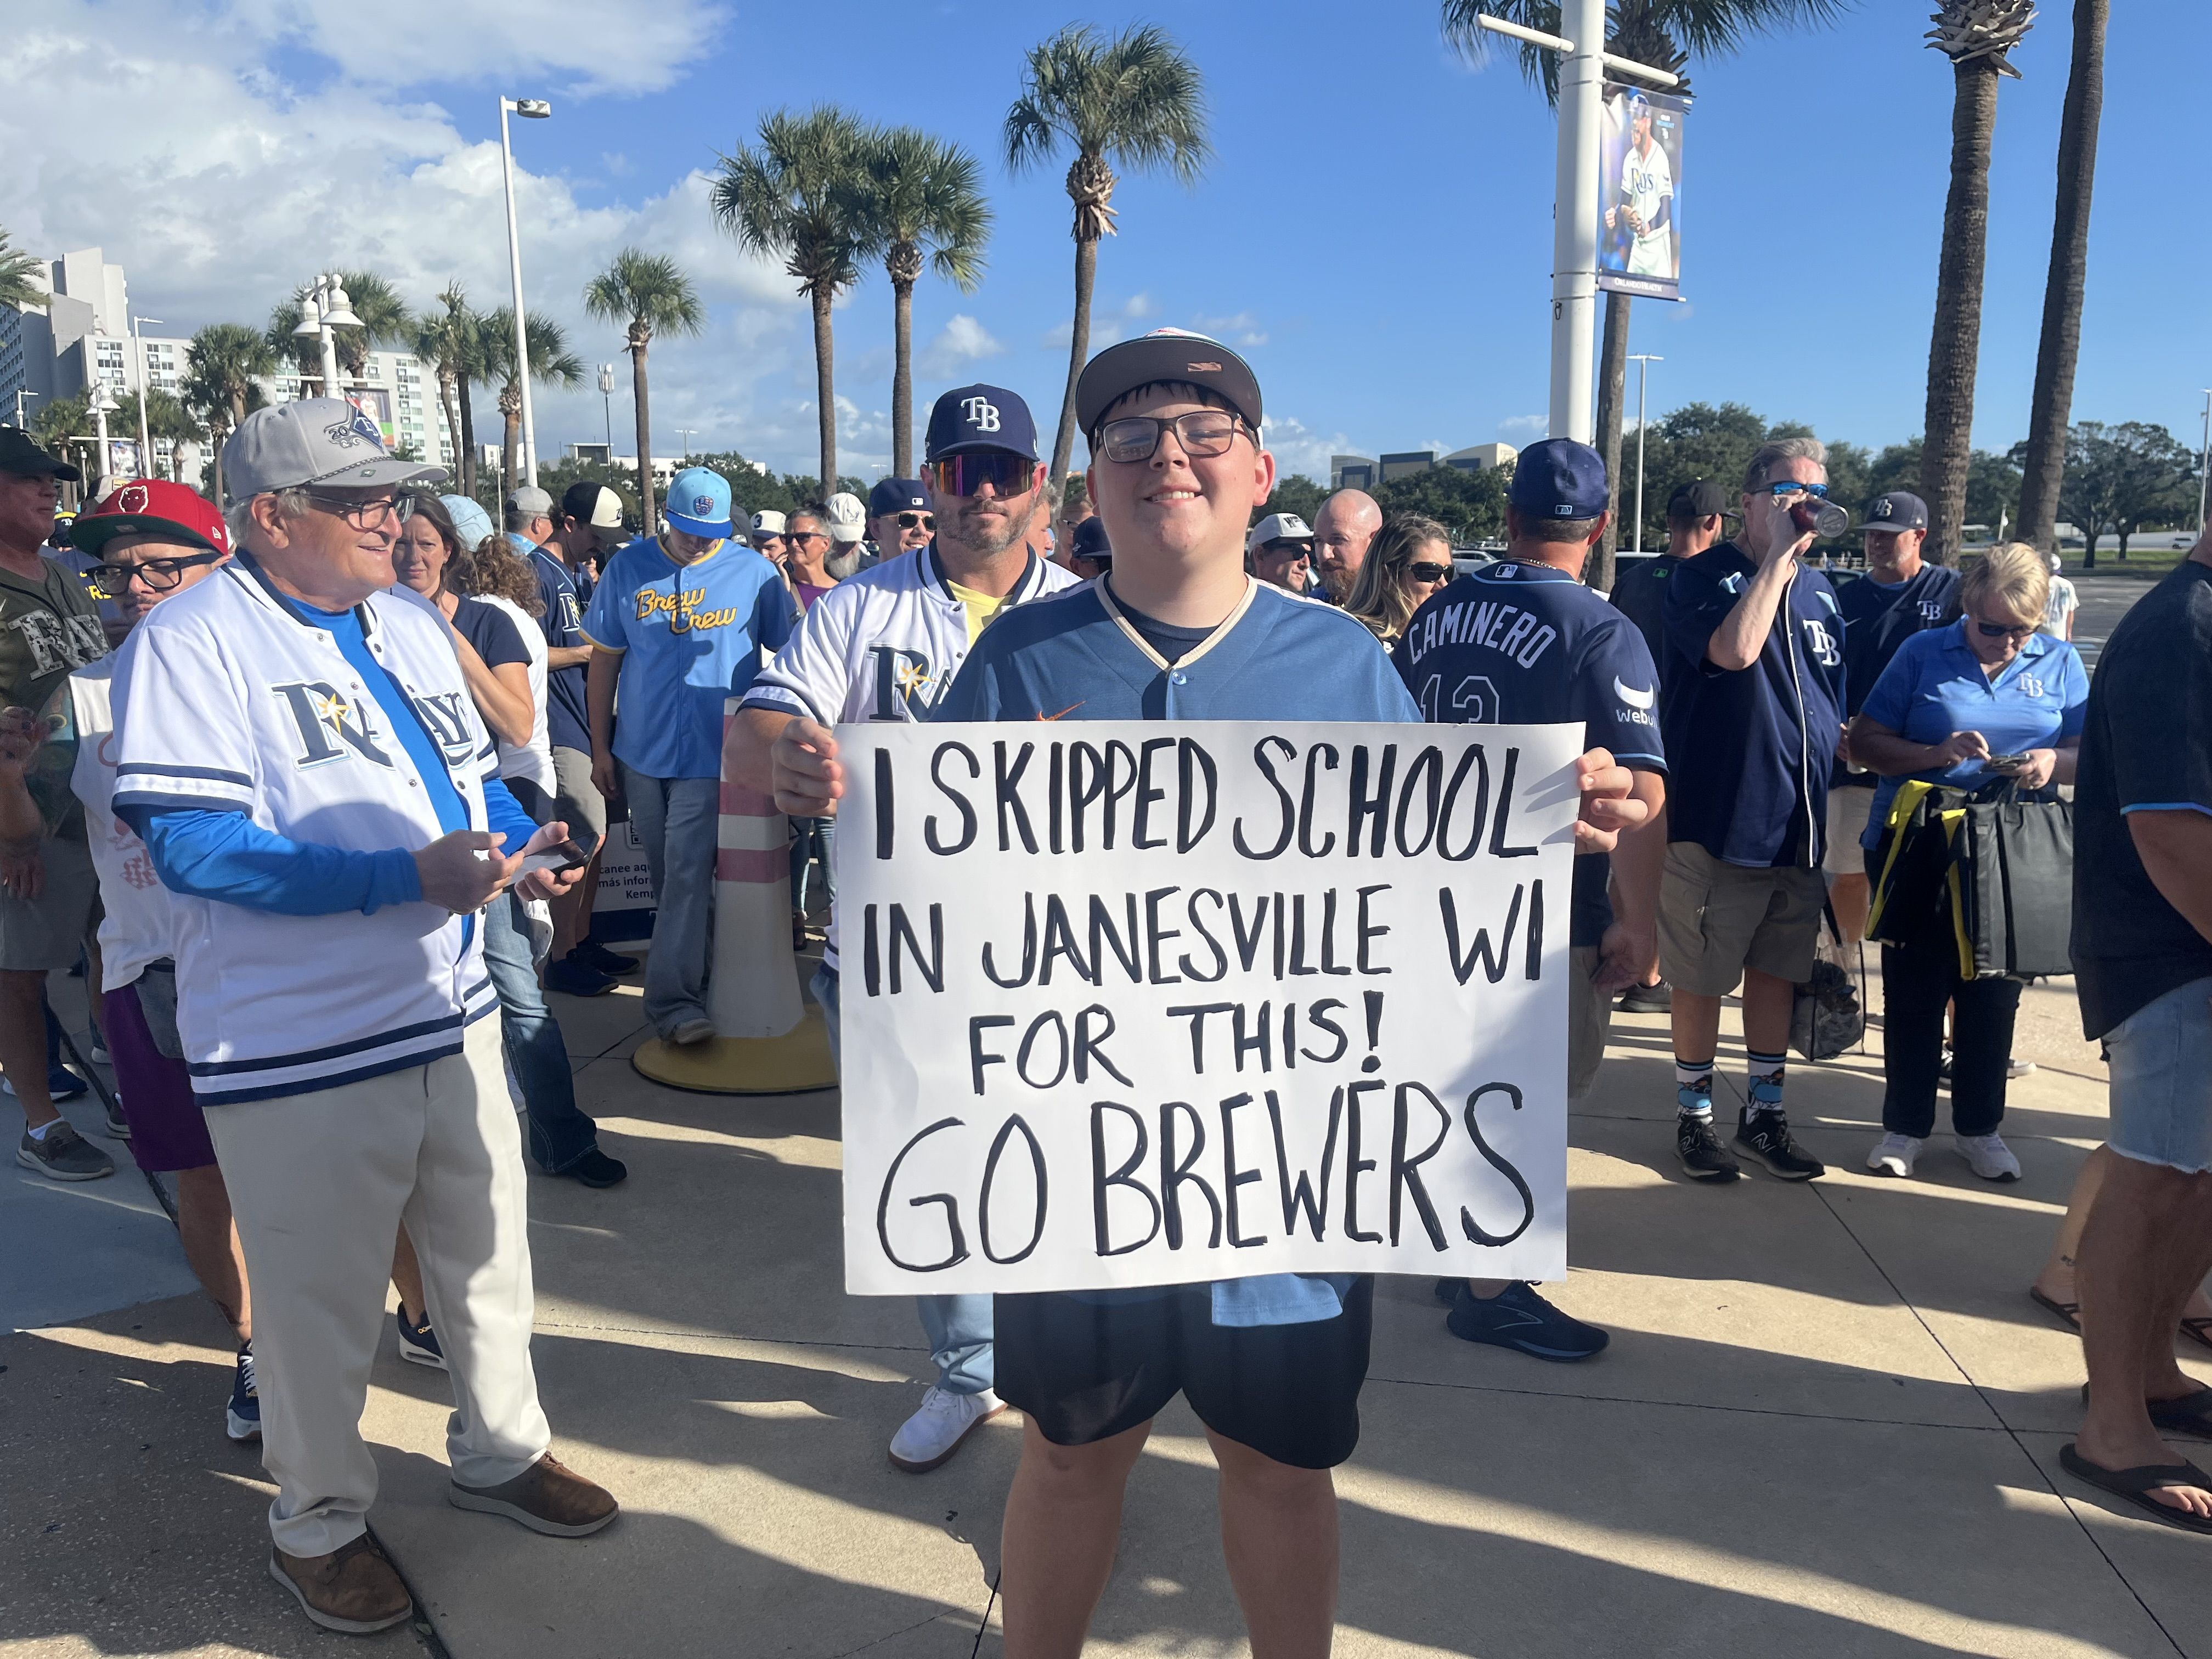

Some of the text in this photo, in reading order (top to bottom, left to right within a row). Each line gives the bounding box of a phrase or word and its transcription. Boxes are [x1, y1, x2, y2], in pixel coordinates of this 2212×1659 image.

[961, 397, 1001, 432] TB
[754, 513, 763, 529] 3
[635, 588, 707, 621] Brew
[670, 607, 737, 635] Crew
[1917, 601, 1941, 620] TB
[1409, 601, 1556, 668] CAMINERO
[1802, 619, 1841, 666] TB
[2017, 672, 2044, 697] TB
[876, 736, 1539, 861] I SKIPPED SCHOOL
[599, 877, 620, 888] más
[864, 879, 1544, 997] IN JANESVILLE WI
[969, 991, 1383, 1096] FOR THIS!
[877, 1080, 1534, 1273] GO BREWERS
